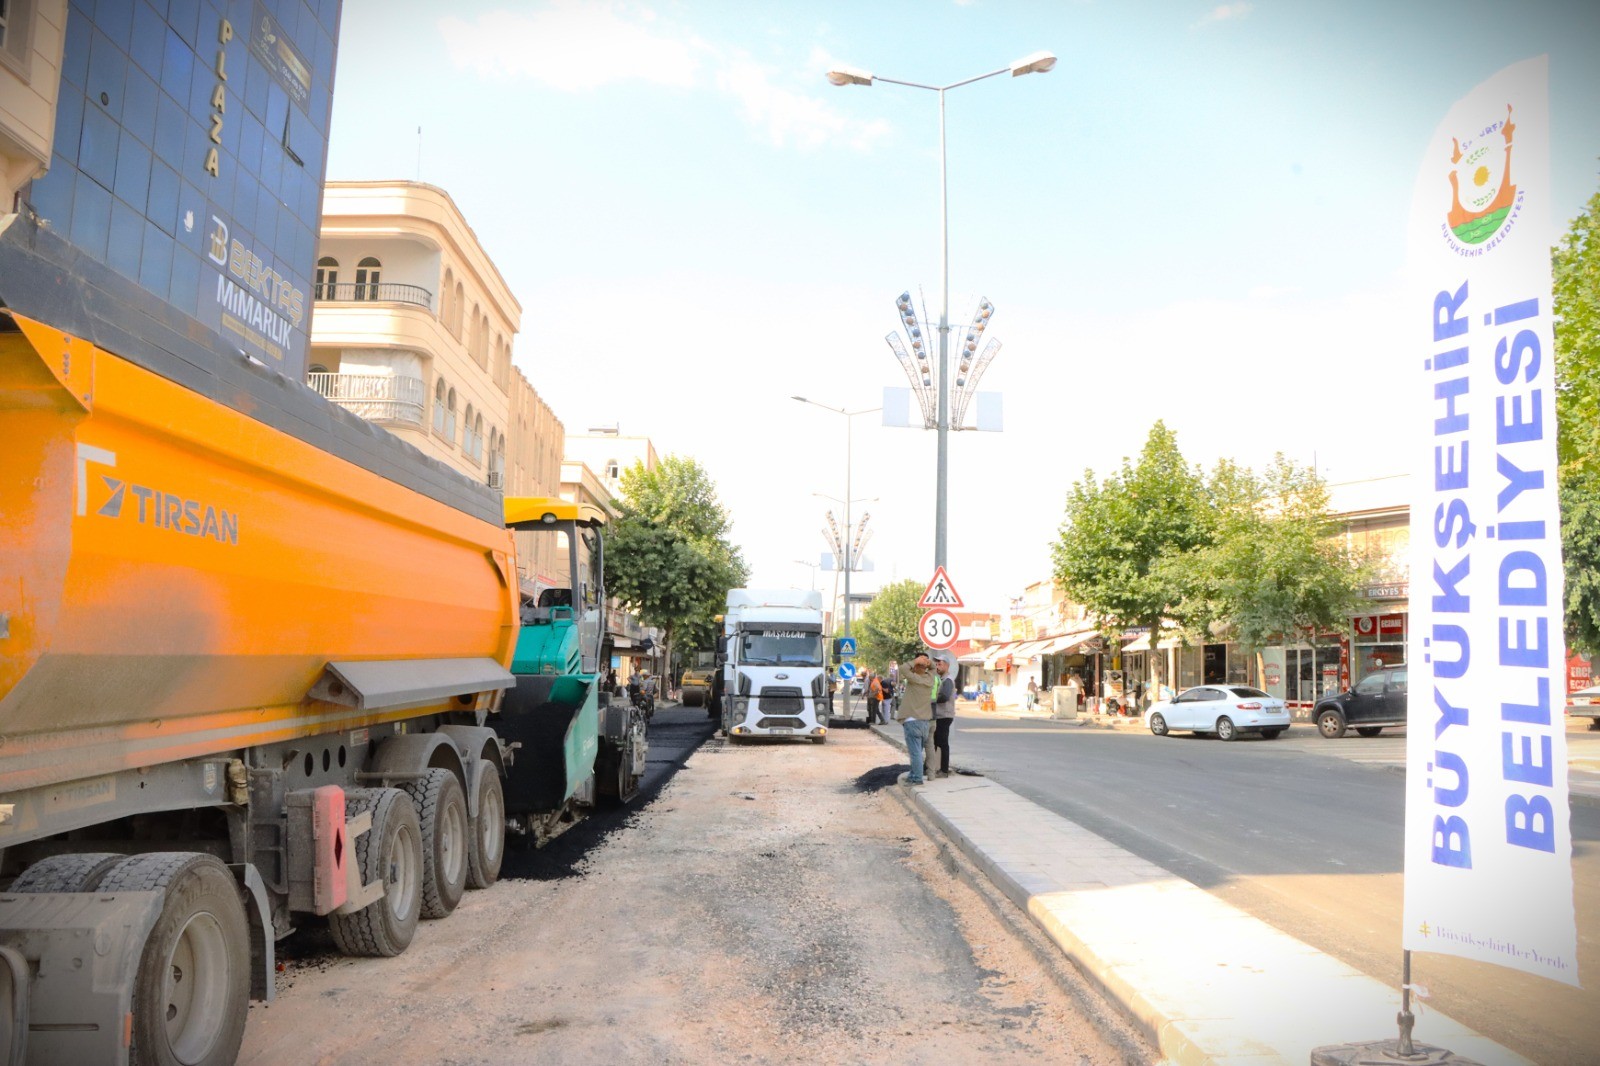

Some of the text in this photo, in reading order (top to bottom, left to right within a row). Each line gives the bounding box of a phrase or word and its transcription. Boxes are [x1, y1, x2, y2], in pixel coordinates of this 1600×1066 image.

[204, 18, 233, 178] PLAZA
[230, 238, 304, 328] BEKTAŞ
[131, 484, 239, 546] TIRSAN
[1424, 278, 1476, 869] BÜYÜKŞEHİR
[1484, 297, 1555, 854] BELEDİYESİ
[928, 619, 952, 637] 30
